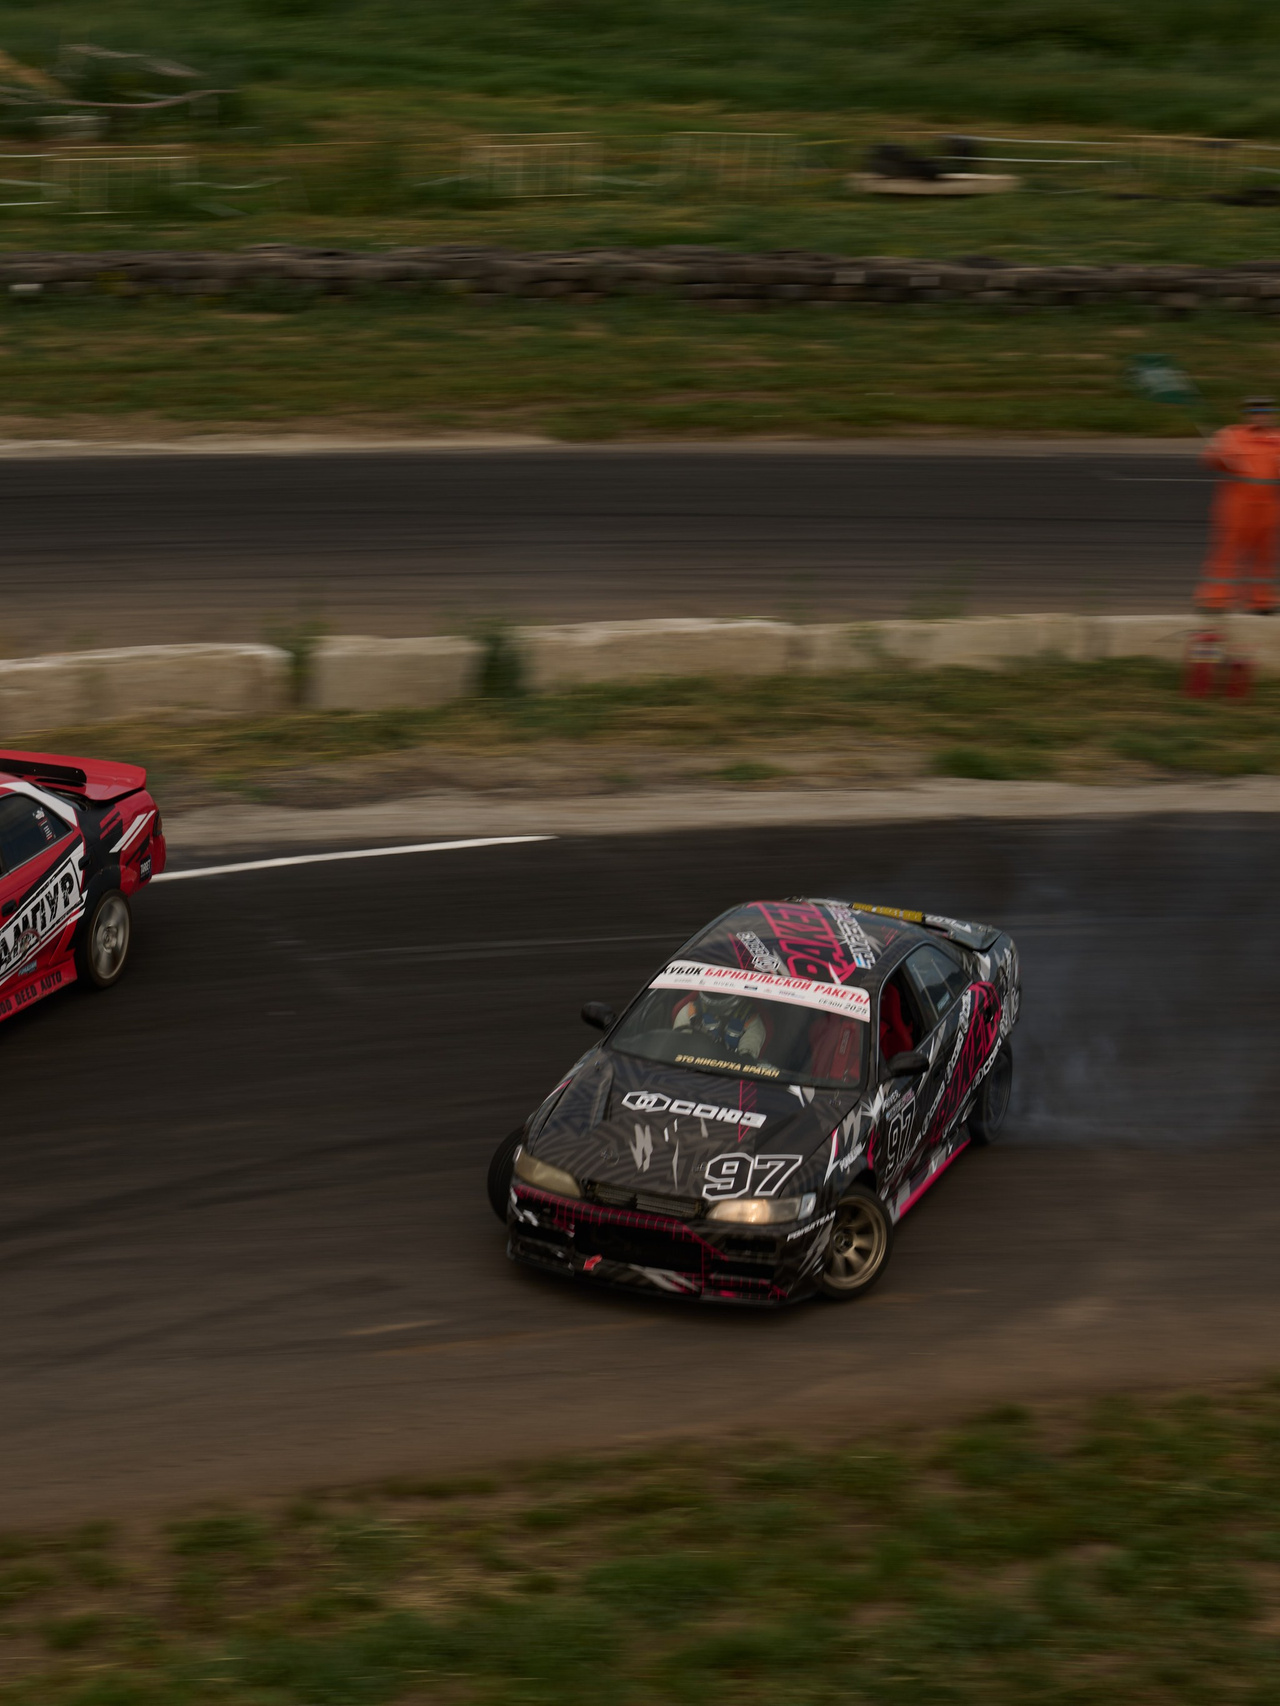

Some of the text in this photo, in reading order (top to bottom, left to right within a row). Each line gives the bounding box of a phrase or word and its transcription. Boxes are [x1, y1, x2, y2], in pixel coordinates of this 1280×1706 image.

[15, 985, 38, 1006] DEED
[41, 971, 63, 992] AUTO
[703, 967, 813, 991] БАРНАУЛЬСКОЙ
[813, 985, 871, 1005] РАКЕТЫ
[675, 1054, 694, 1064] ЭТО
[884, 1096, 915, 1184] 97
[702, 1152, 803, 1202] 97
